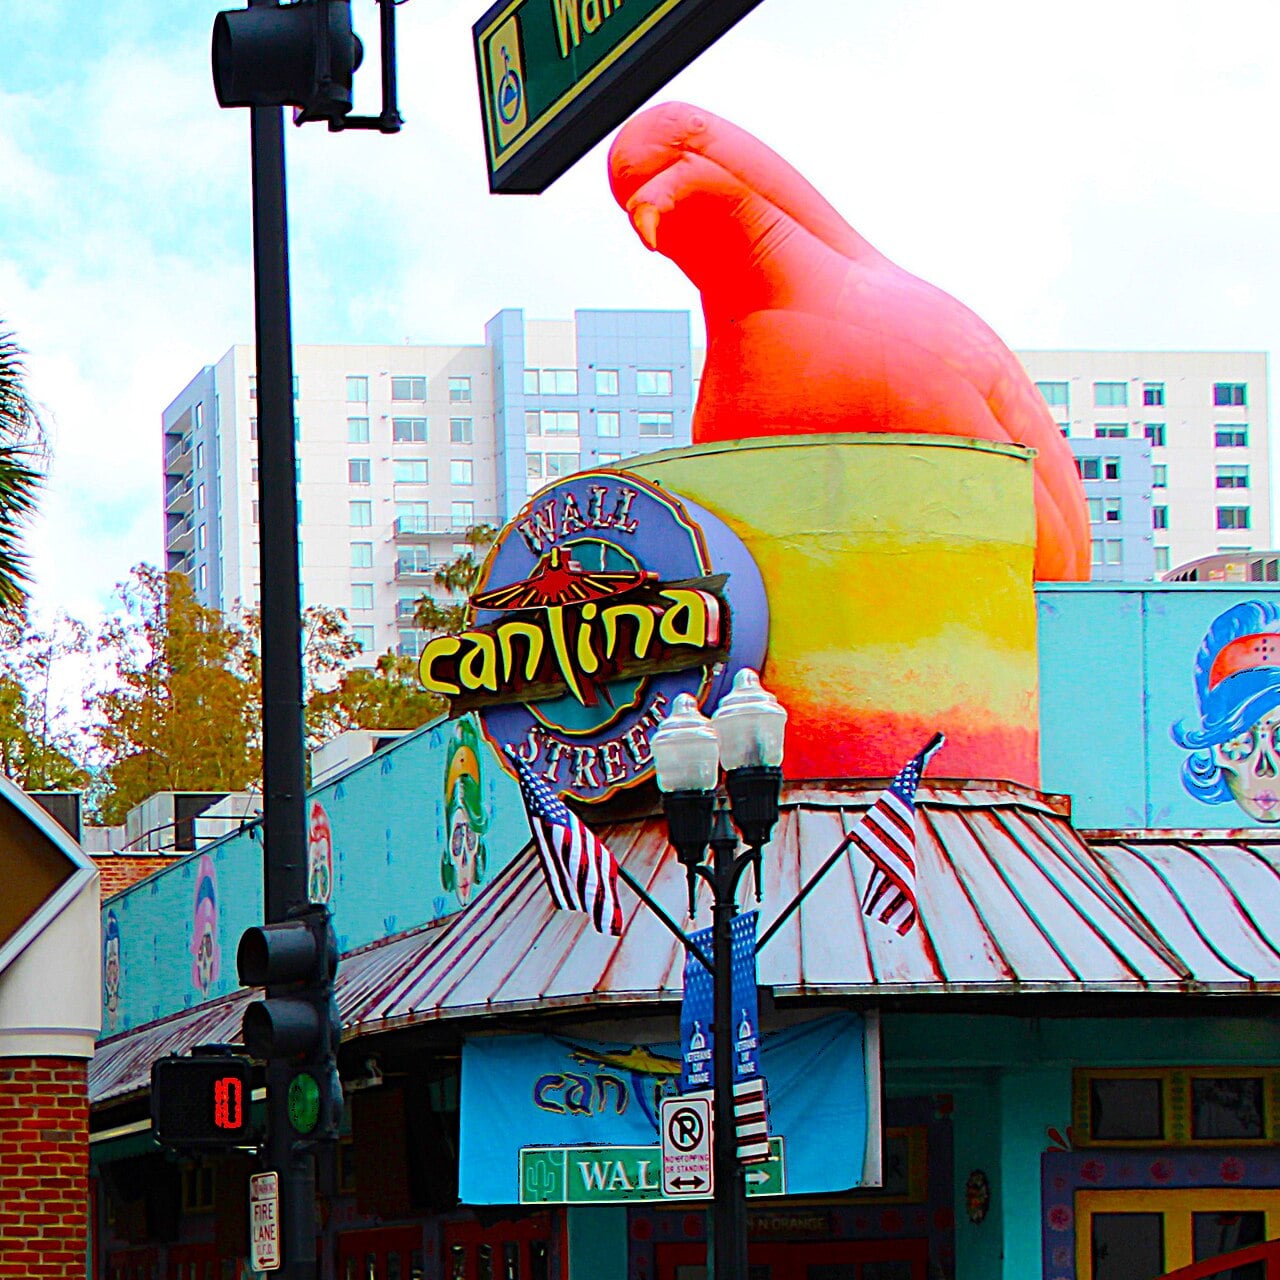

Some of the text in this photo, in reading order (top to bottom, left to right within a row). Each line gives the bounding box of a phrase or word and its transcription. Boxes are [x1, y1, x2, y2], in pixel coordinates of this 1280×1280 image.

[517, 486, 639, 555] WALL
[419, 588, 720, 705] cantina
[518, 693, 668, 788] STREET
[254, 1203, 273, 1221] FIRE
[254, 1224, 276, 1243] LANE
